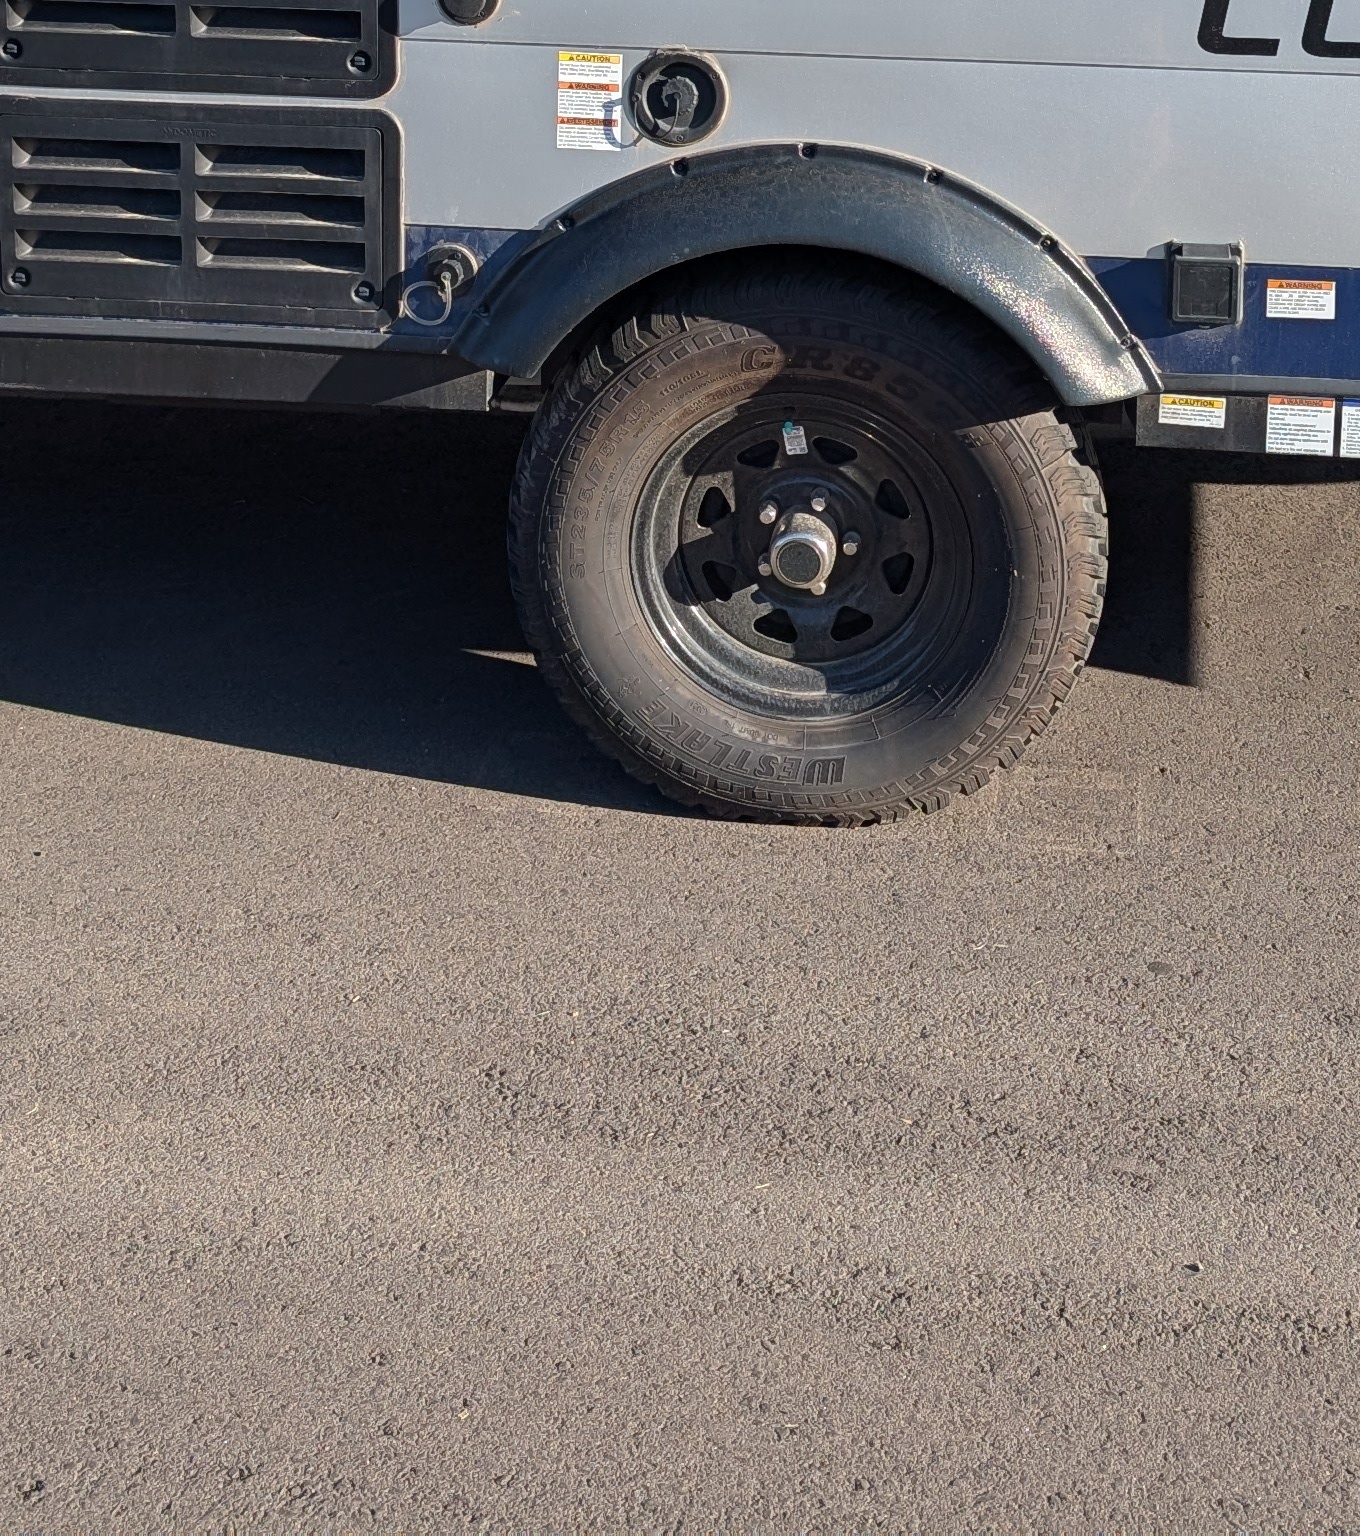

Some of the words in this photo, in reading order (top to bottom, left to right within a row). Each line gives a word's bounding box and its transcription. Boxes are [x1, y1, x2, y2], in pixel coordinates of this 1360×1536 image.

[575, 55, 610, 63] CAUTION
[1285, 281, 1322, 290] WARNING
[1179, 398, 1214, 407] CAUTION
[633, 697, 848, 786] WESTLAKE
